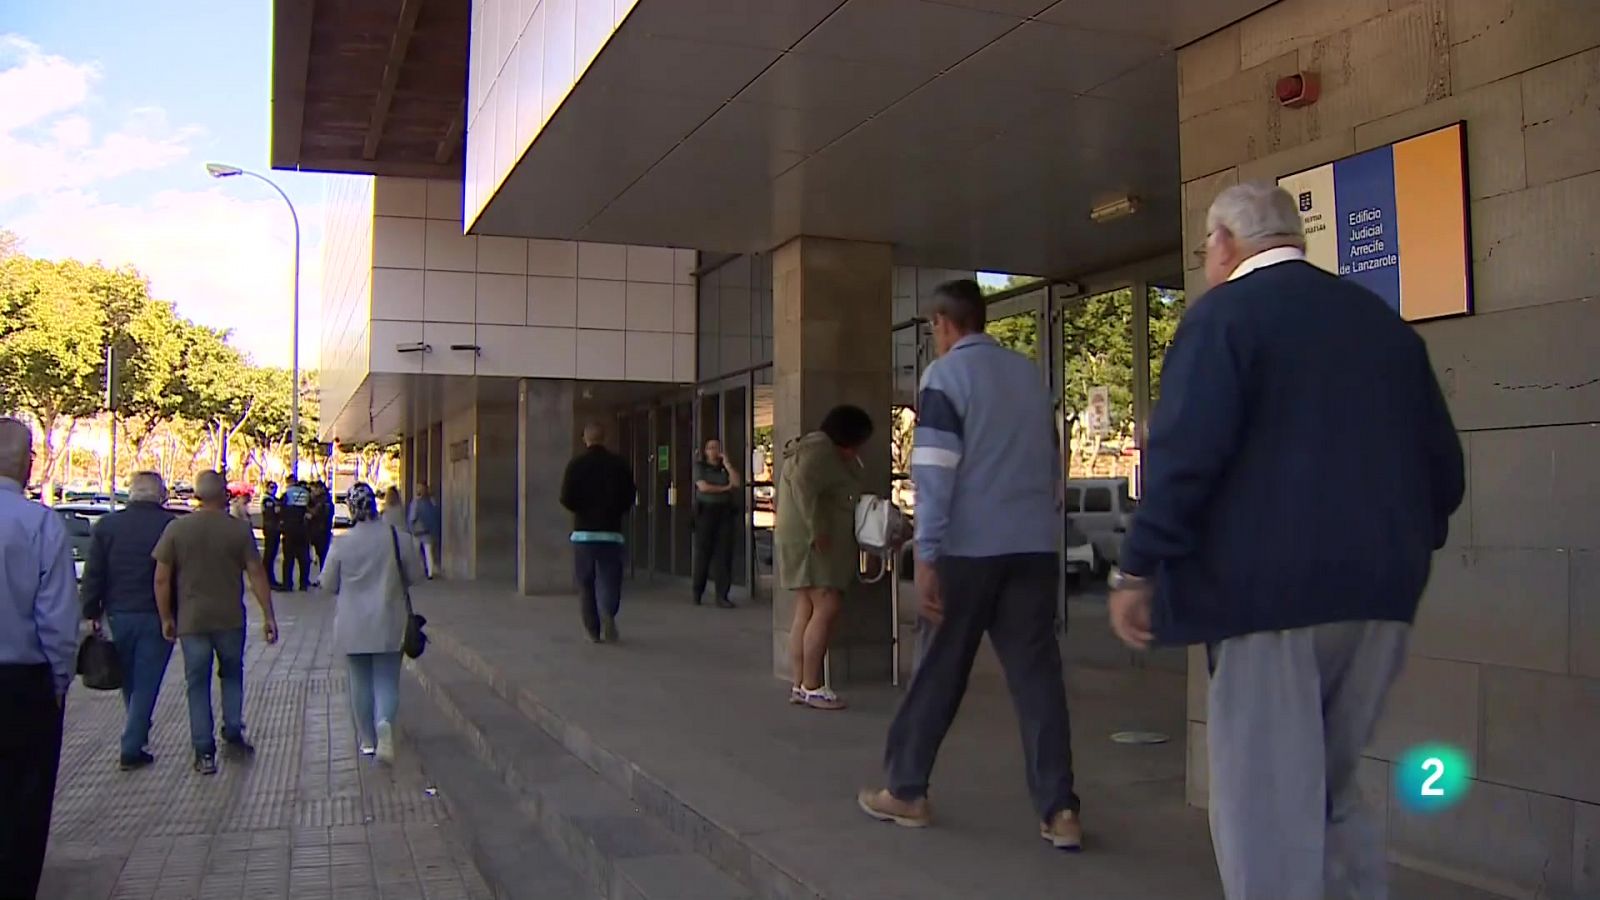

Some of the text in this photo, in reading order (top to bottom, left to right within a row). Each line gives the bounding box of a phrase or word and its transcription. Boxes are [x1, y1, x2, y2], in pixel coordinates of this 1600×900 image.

[1349, 208, 1381, 226] Edificio
[1349, 223, 1383, 242] Judicial
[1350, 239, 1384, 258] Arrecife
[1339, 254, 1397, 275] de Lanzarote
